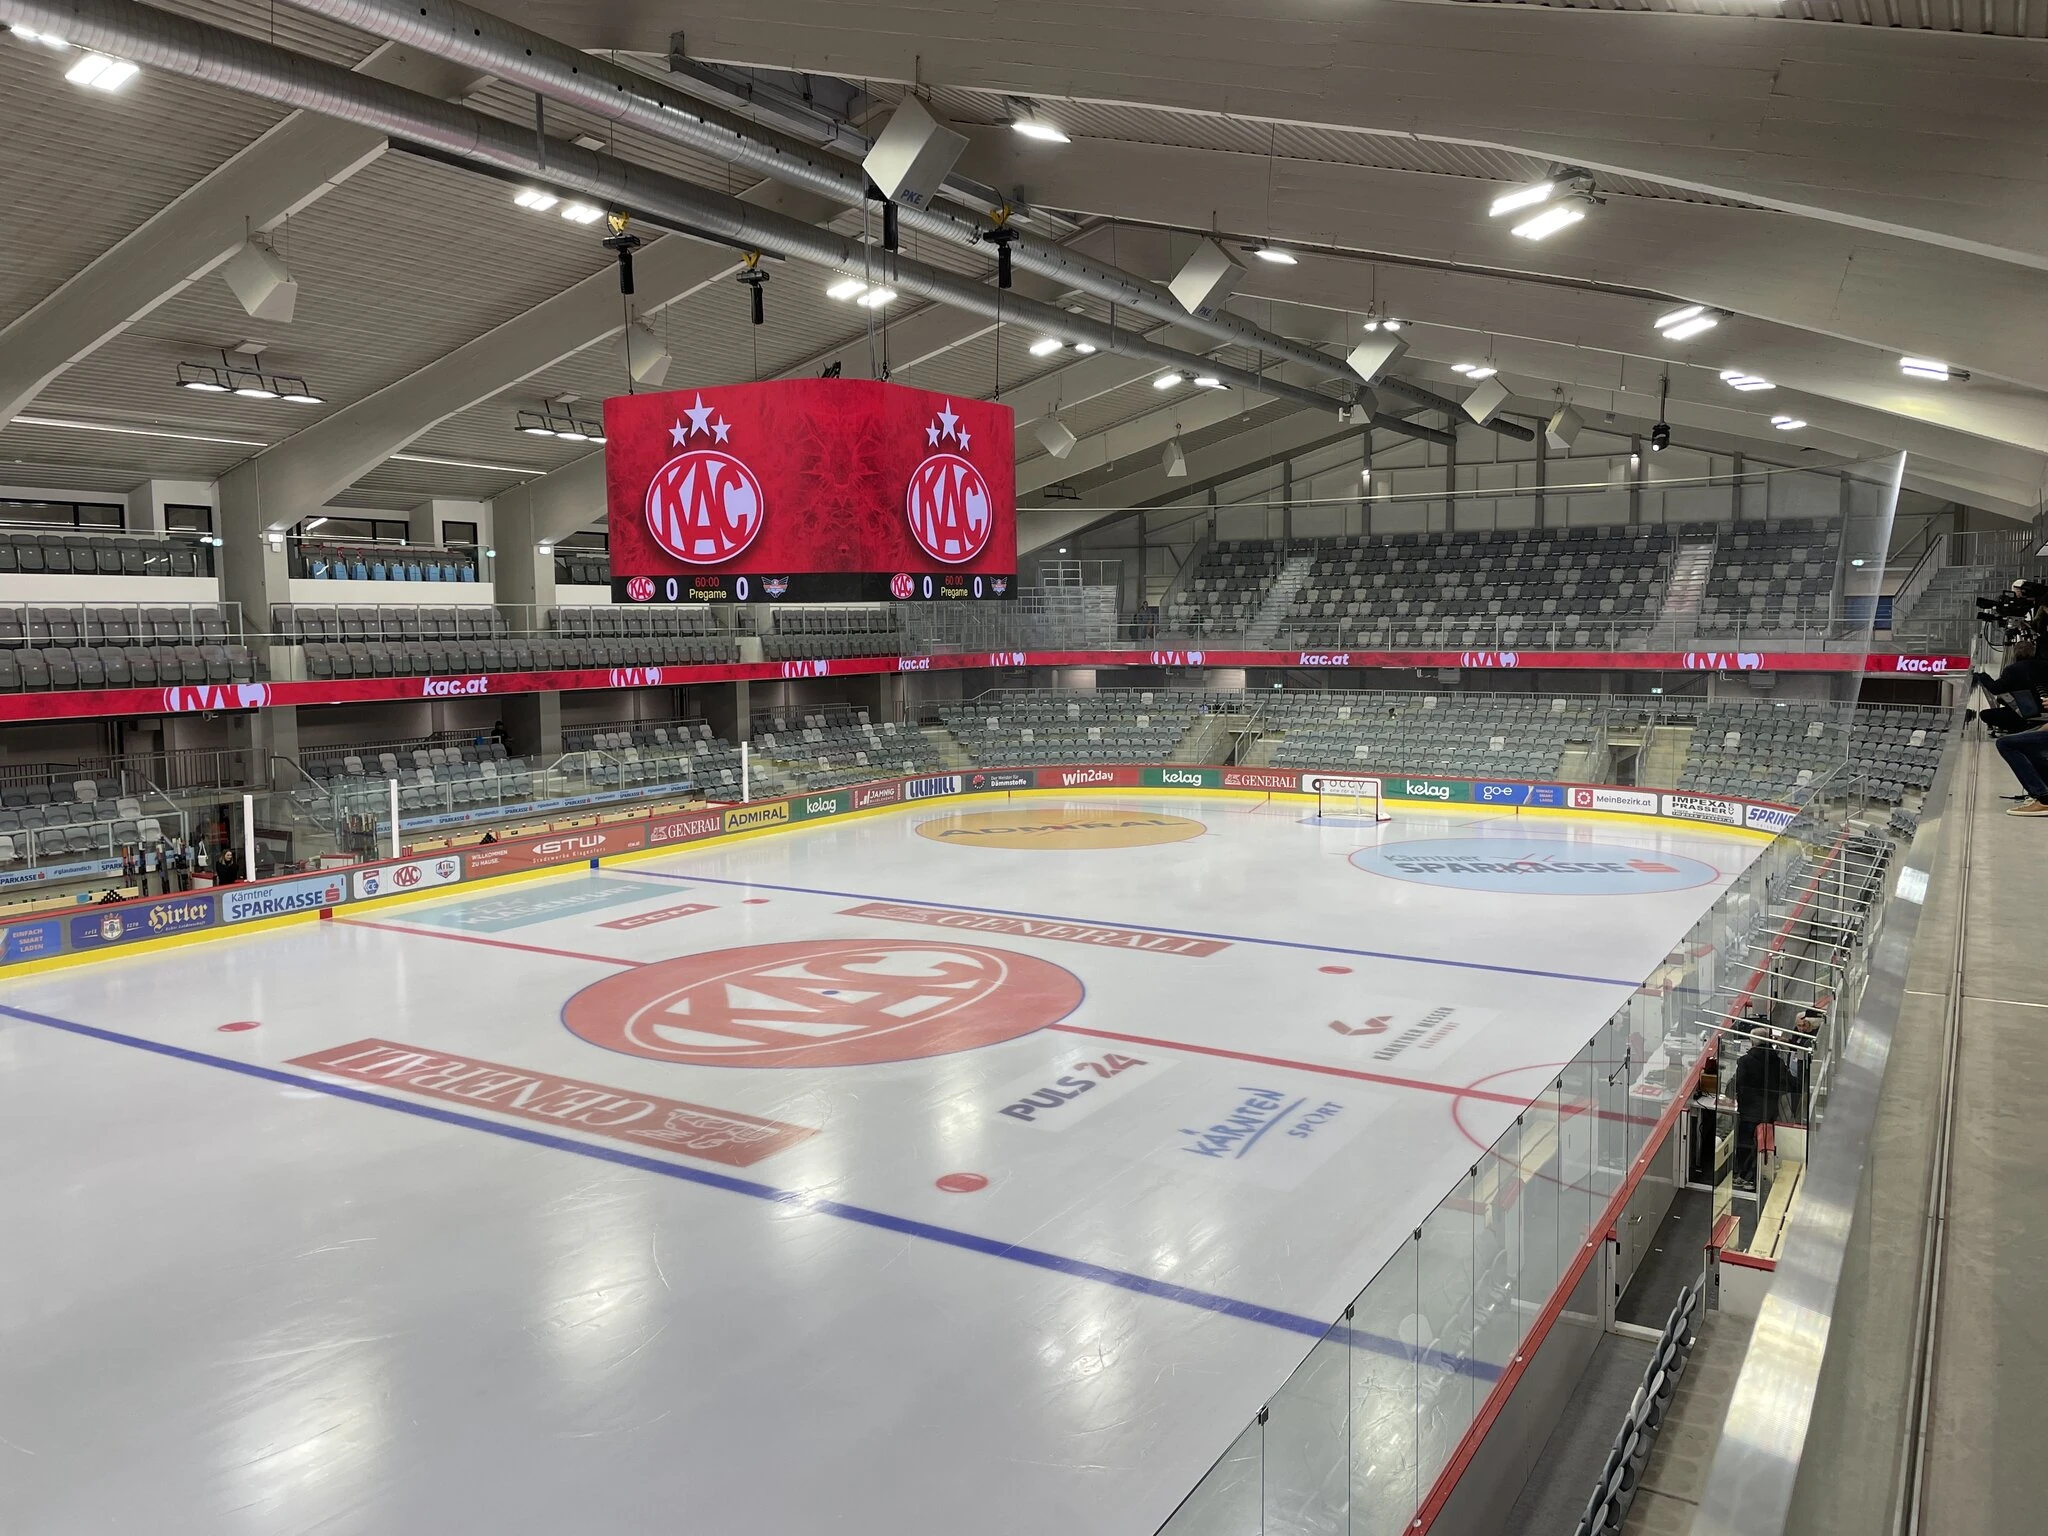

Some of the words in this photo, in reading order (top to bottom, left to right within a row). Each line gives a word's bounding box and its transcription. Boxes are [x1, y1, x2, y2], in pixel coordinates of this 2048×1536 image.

[901, 189, 923, 205] PKE
[654, 458, 758, 558] KAC
[912, 460, 987, 558] KAC
[628, 577, 655, 600] KAC
[666, 577, 678, 600] 0
[695, 576, 719, 587] 60:00
[736, 577, 748, 600] 0
[891, 574, 914, 598] KAC
[923, 575, 933, 599] 0
[974, 576, 982, 598] 0
[689, 589, 727, 601] Pregame
[941, 587, 968, 599] Pregame
[898, 657, 930, 670] kac.at
[1300, 652, 1349, 665] kac.at
[1896, 656, 1947, 672] kac.at
[423, 677, 488, 696] kac.at
[1062, 769, 1113, 786] win2day
[1162, 769, 1202, 786] kelag
[1241, 775, 1297, 788] GENERALI
[869, 788, 895, 799] JAMNIG
[1406, 780, 1450, 799] kelag
[806, 798, 836, 814] kelag
[1597, 795, 1651, 806] MeinBezirk.at
[1672, 796, 1727, 810] IMPEXA
[1672, 803, 1727, 815] PRASSER
[439, 816, 465, 824] SPARKASSE
[728, 806, 787, 829] ADMIRAL
[668, 817, 720, 838] GENERALI
[939, 819, 1189, 837] ADMIRAL
[542, 835, 596, 854] STW
[471, 850, 508, 860] WILLKOMMEN
[1383, 854, 1481, 862] Kärntner
[471, 860, 480, 868] ZU
[1394, 861, 1635, 874] SPARKASSE
[0, 874, 37, 885] PARKASSE
[394, 867, 421, 886] KAC
[231, 887, 273, 903] Kärntner
[231, 890, 323, 920] SPARKASSE
[148, 902, 208, 930] Hirter
[620, 905, 701, 927] CCM
[12, 928, 43, 938] EINFACH
[19, 936, 43, 945] SMART
[937, 913, 1207, 954] GENERALI
[20, 944, 43, 953] LADEN
[636, 949, 998, 1052] KAC
[318, 1046, 656, 1128] GENERALI
[998, 1076, 1096, 1122] PULS
[1075, 1053, 1149, 1079] 24
[1178, 1086, 1285, 1159] KÄRNTEN
[1286, 1100, 1345, 1139] SPORT
